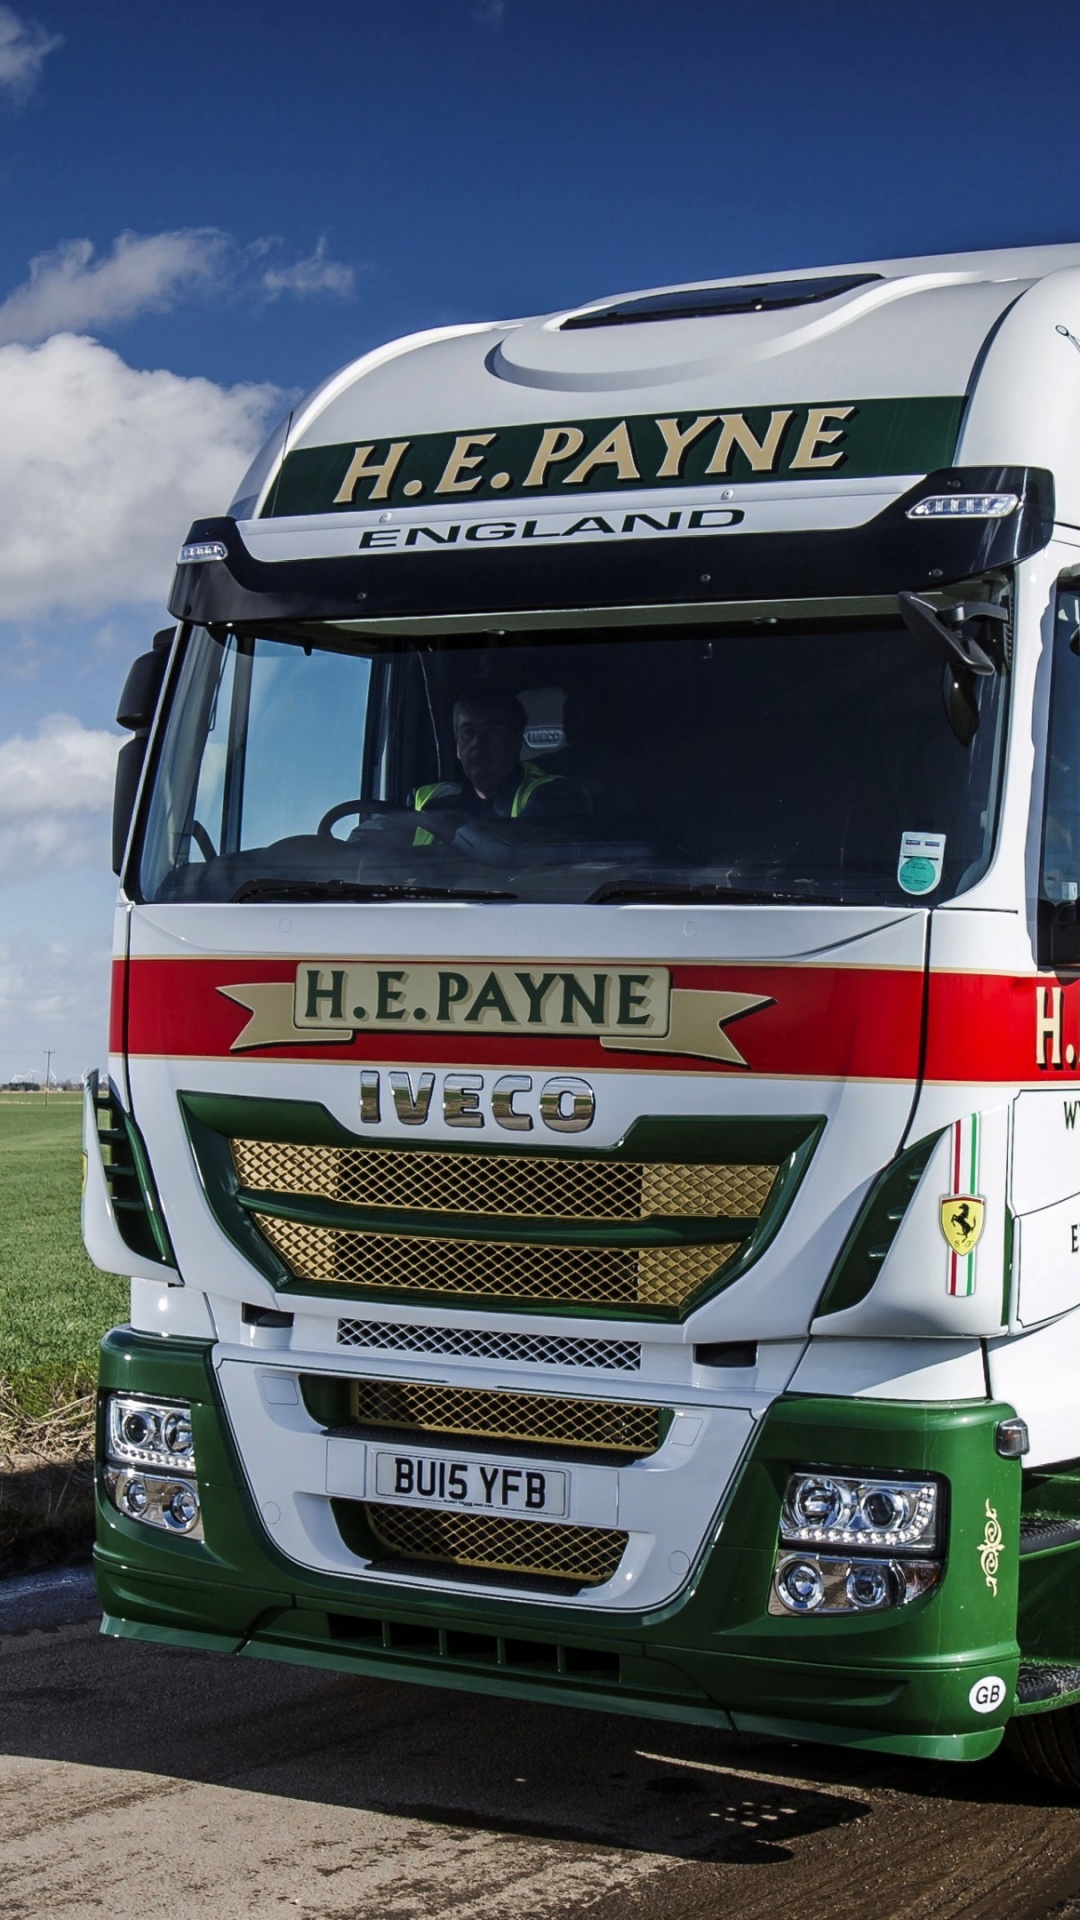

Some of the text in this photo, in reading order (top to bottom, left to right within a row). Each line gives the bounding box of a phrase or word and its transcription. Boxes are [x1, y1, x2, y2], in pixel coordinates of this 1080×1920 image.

[332, 406, 857, 505] H.E.PAYNE
[358, 509, 745, 549] ENGLAND
[304, 969, 654, 1026] H.E.PAYNE
[359, 1070, 596, 1133] IVECO
[1071, 1223, 1080, 1253] E
[394, 1457, 546, 1509] BU15 YFB
[975, 1684, 1000, 1705] GB
